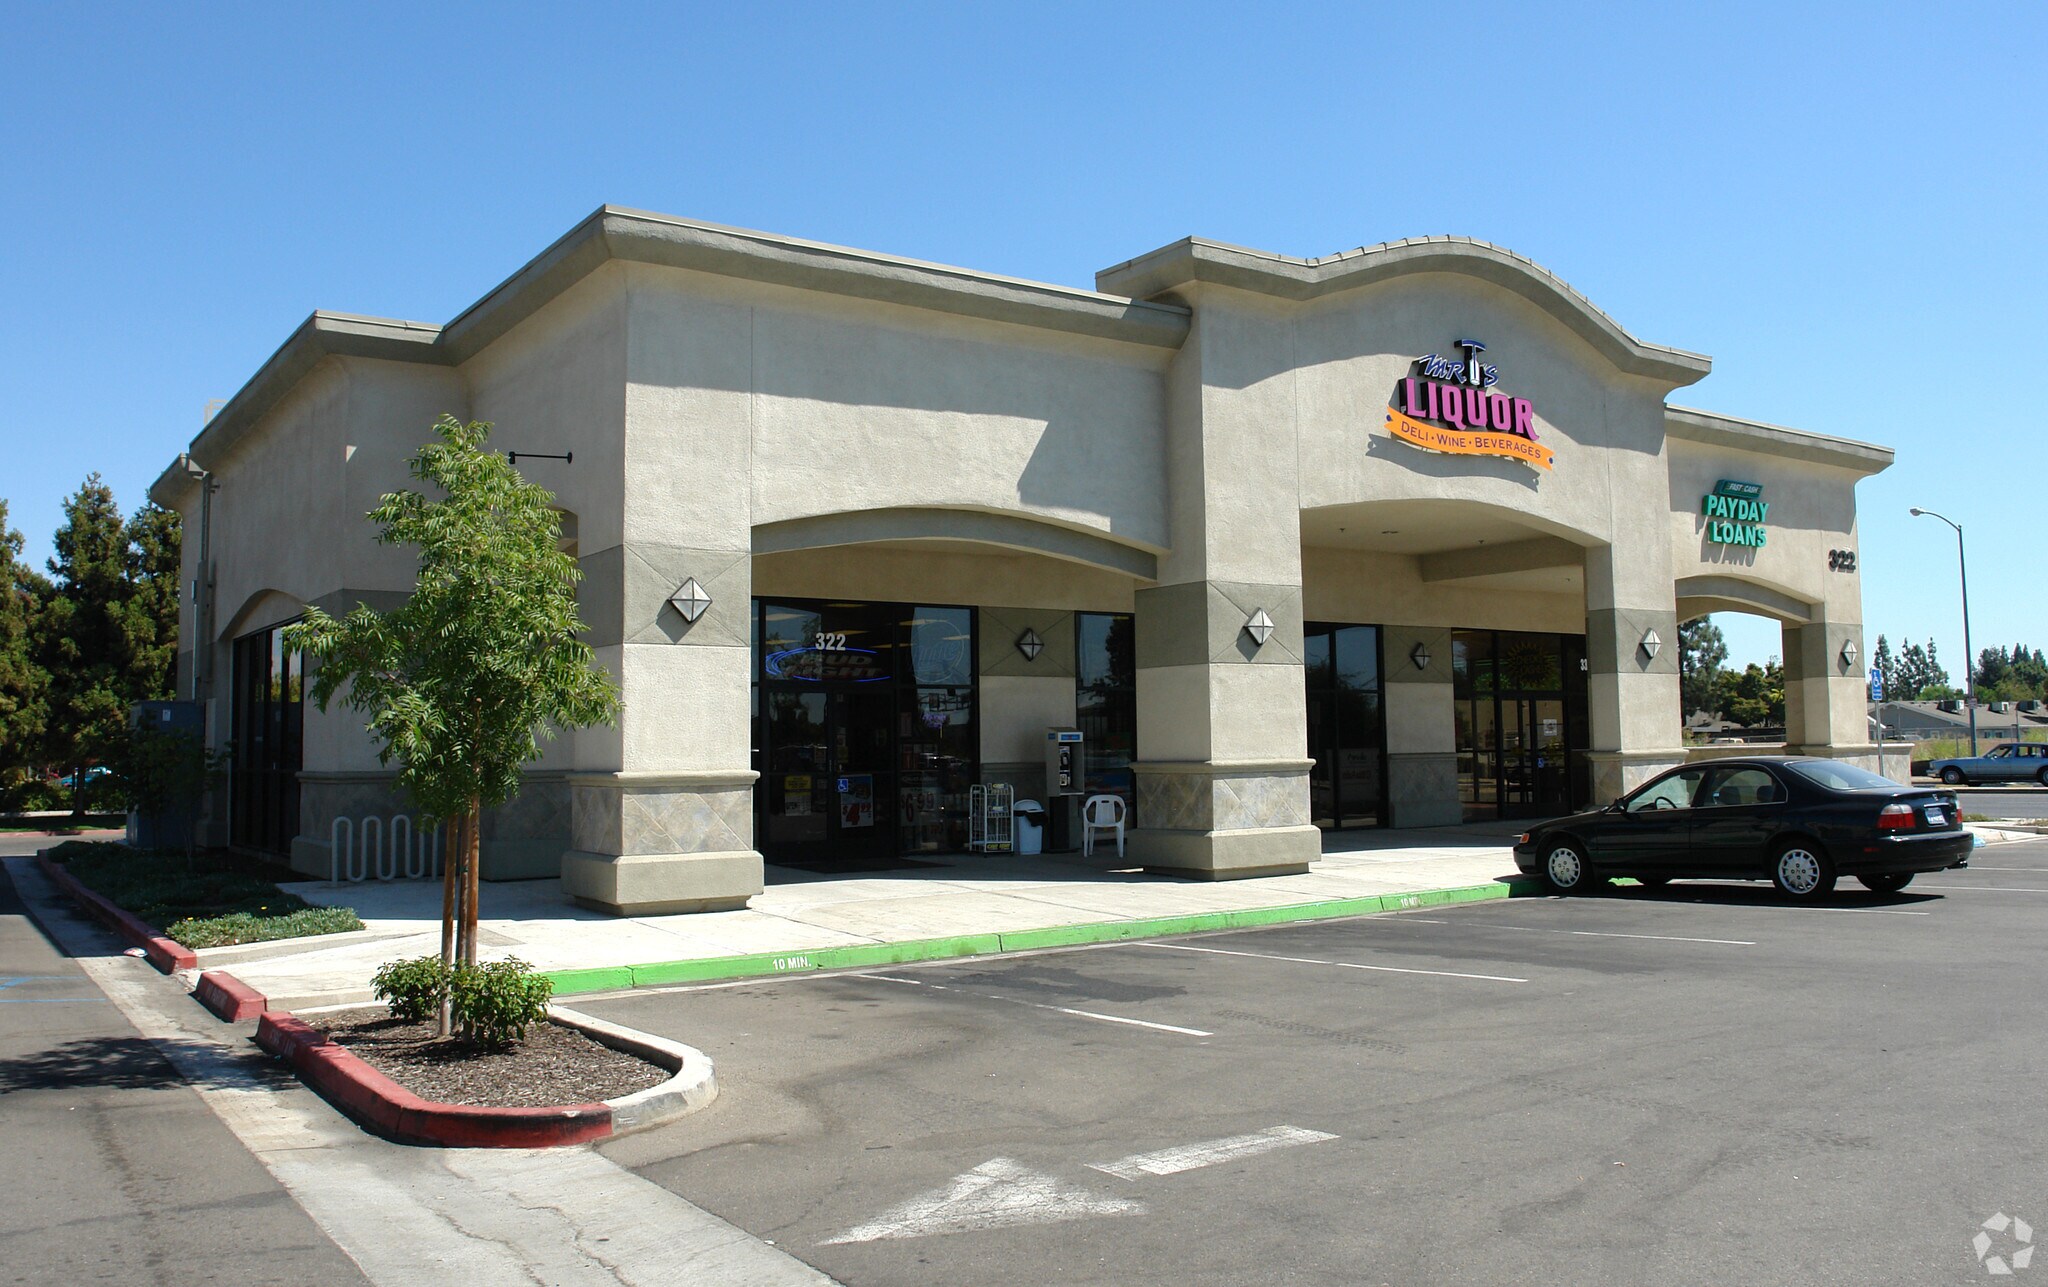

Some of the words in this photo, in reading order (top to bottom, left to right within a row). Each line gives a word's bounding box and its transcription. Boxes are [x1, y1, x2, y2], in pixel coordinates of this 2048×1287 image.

[1406, 378, 1540, 441] LIQUOR
[1401, 421, 1429, 442] DELI
[1437, 433, 1467, 448] WINE
[1475, 436, 1541, 459] BEVERAGES
[1744, 485, 1759, 494] CASH
[1707, 495, 1769, 523] PAYDAY
[1713, 521, 1767, 547] LOANS
[1829, 549, 1856, 571] 322
[815, 632, 847, 651] 322
[773, 958, 786, 970] 10
[788, 956, 812, 969] MIN.
